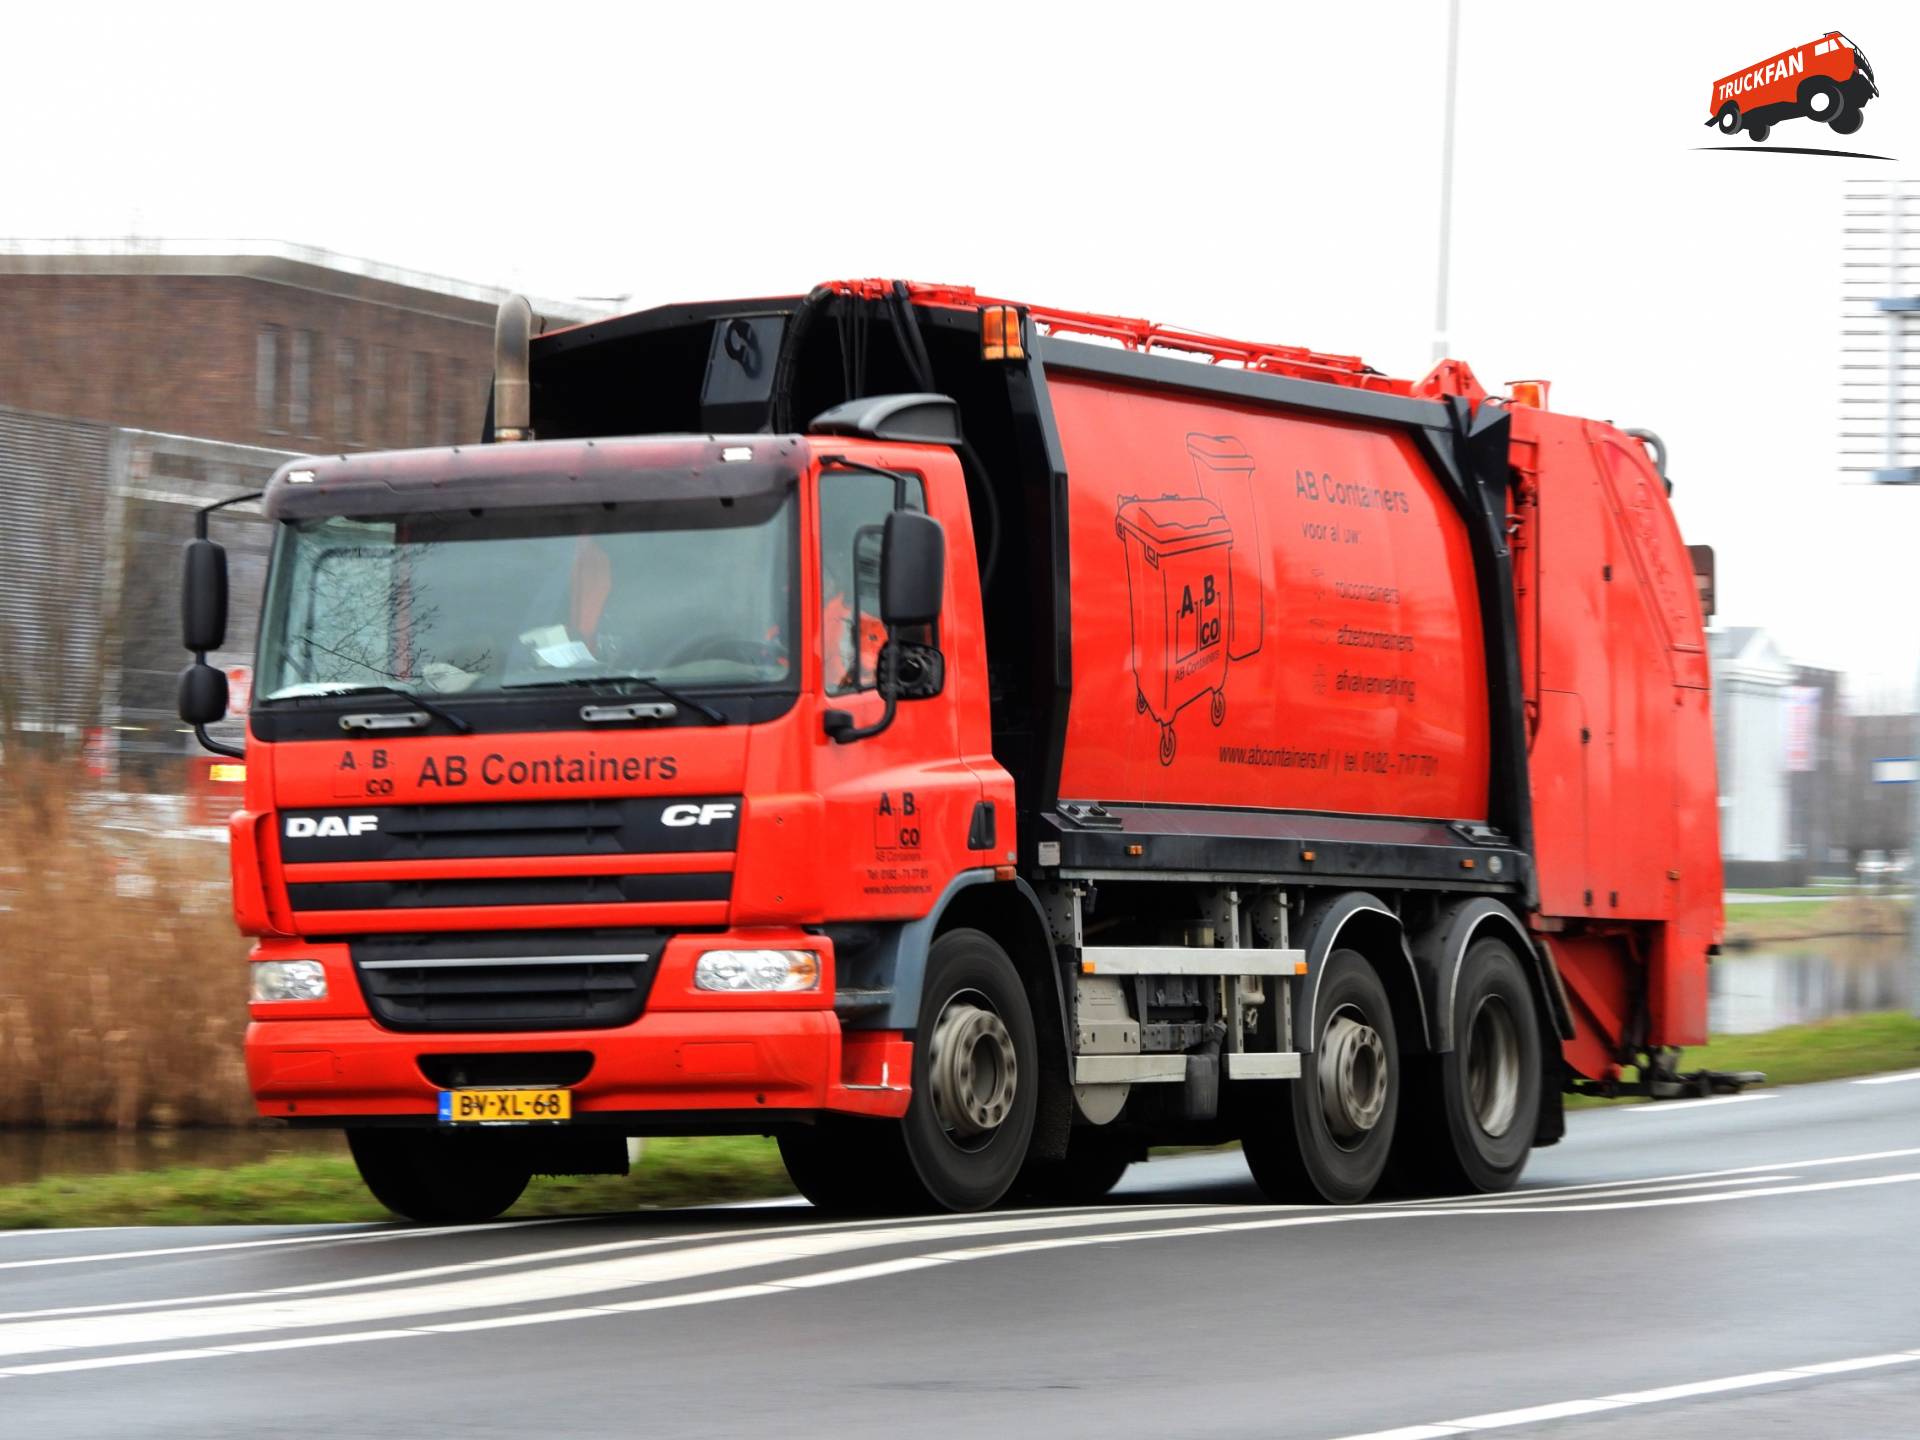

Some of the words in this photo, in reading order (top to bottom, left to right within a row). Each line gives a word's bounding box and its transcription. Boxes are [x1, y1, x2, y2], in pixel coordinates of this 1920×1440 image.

[1296, 469, 1319, 501] AB
[1322, 473, 1410, 514] Containers
[1302, 520, 1328, 541] voor
[1181, 584, 1194, 619] A
[1204, 574, 1215, 607] B
[1201, 618, 1219, 645] CO
[339, 751, 357, 770] A
[372, 750, 388, 769] B
[417, 755, 468, 788] AB
[481, 751, 677, 786] Containers
[366, 779, 393, 796] CO
[661, 803, 736, 827] CF
[878, 792, 892, 816] A
[903, 792, 915, 816] B
[285, 815, 378, 838] DAF
[900, 828, 920, 846] CO
[460, 1093, 561, 1116] BV-XL-68
